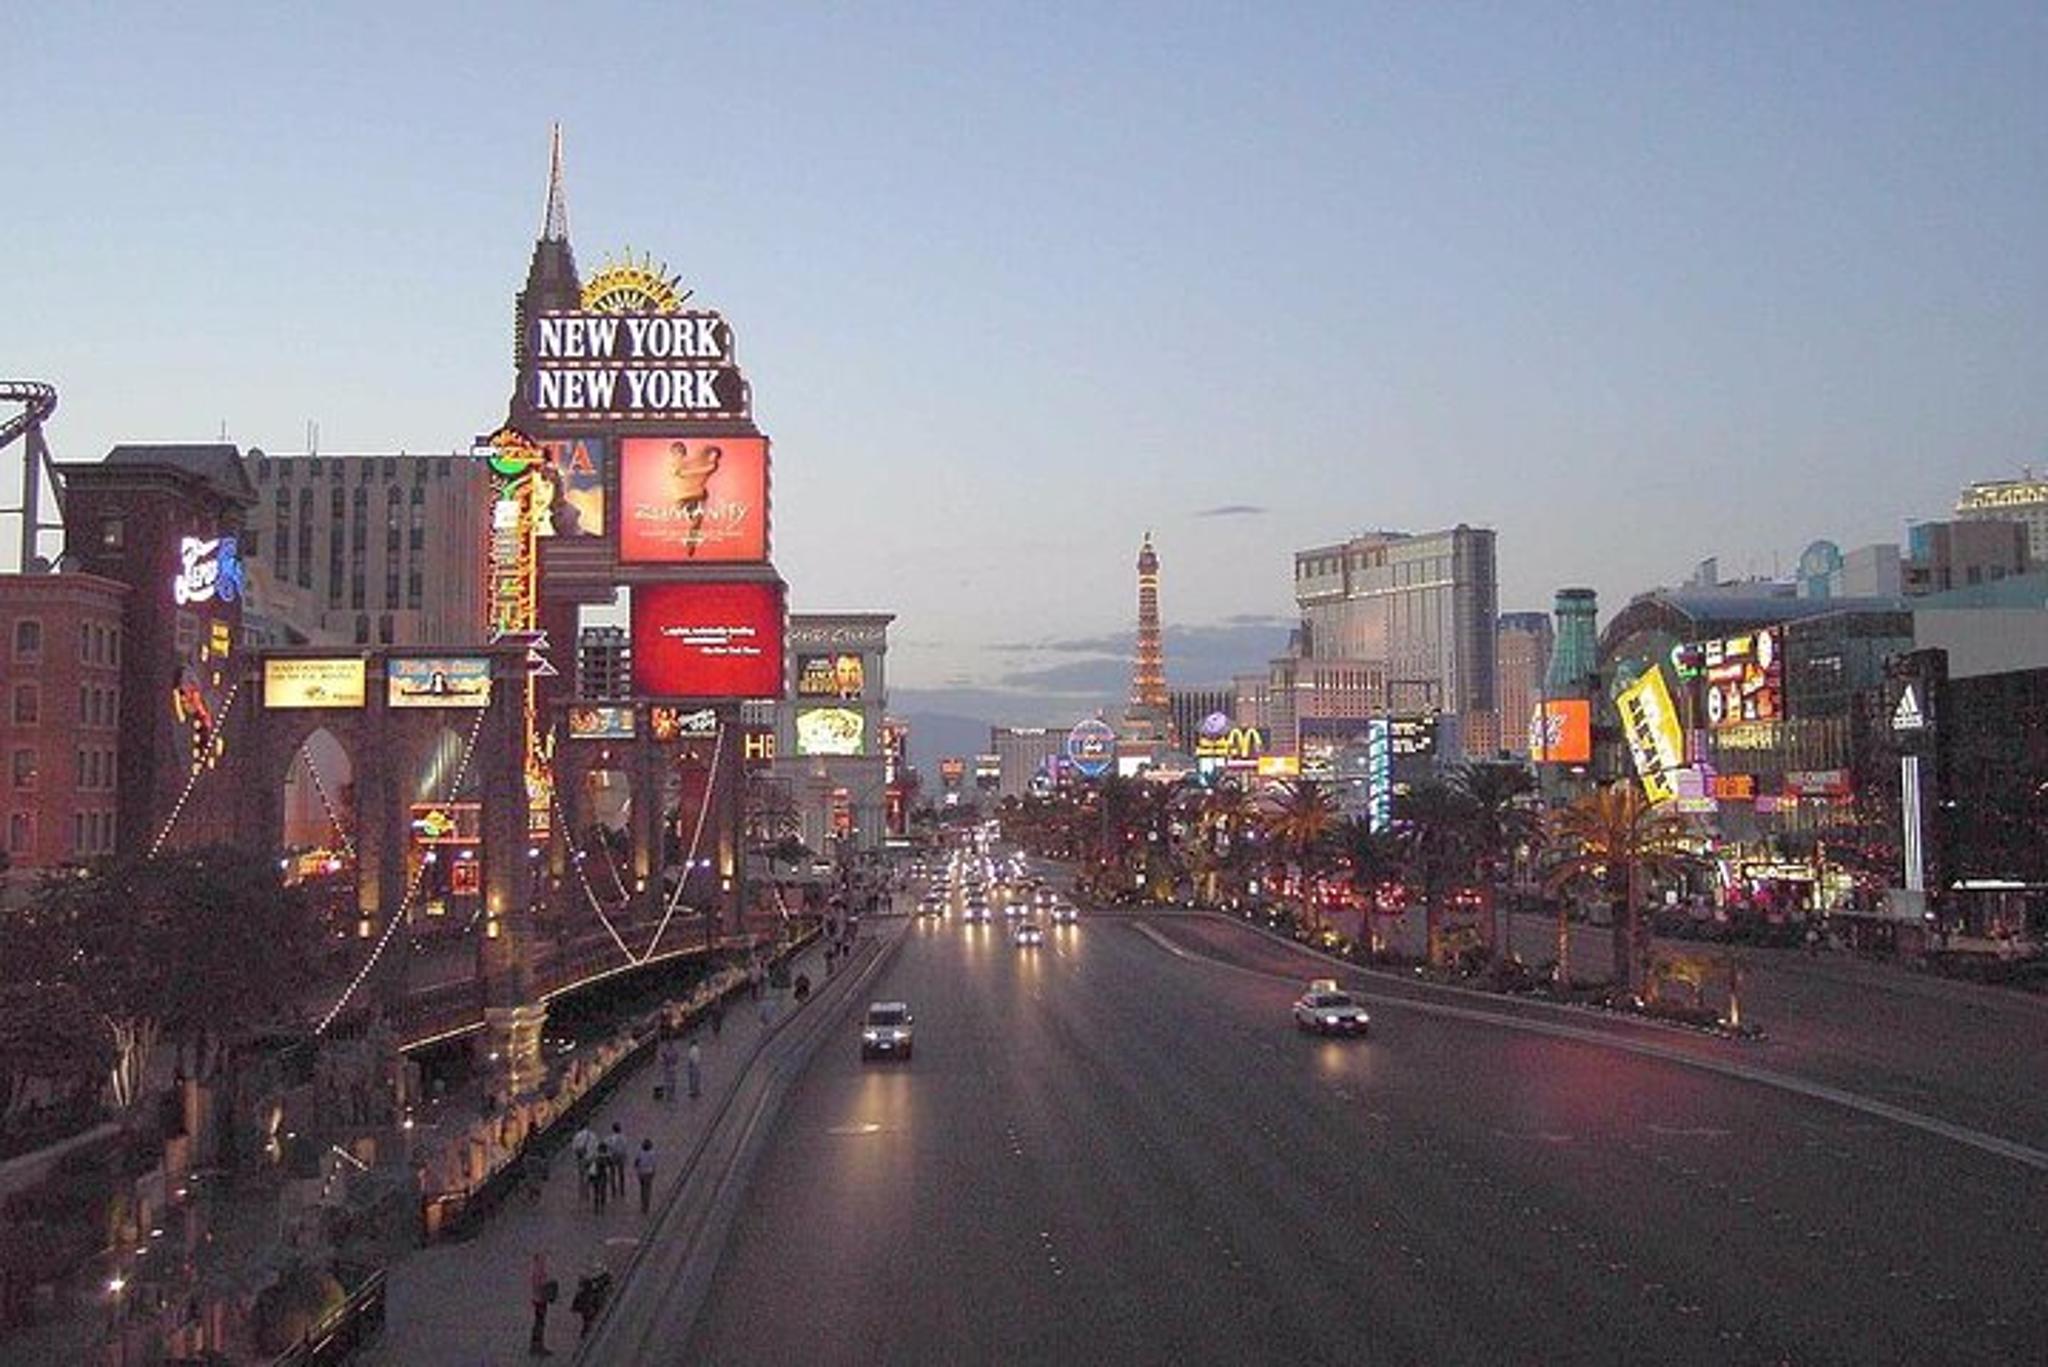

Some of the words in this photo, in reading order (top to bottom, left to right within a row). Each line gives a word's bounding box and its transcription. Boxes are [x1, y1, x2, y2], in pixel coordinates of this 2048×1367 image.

[538, 318, 619, 357] NEW
[626, 318, 721, 357] YORK
[537, 369, 618, 409] NEW
[624, 369, 721, 409] YORK
